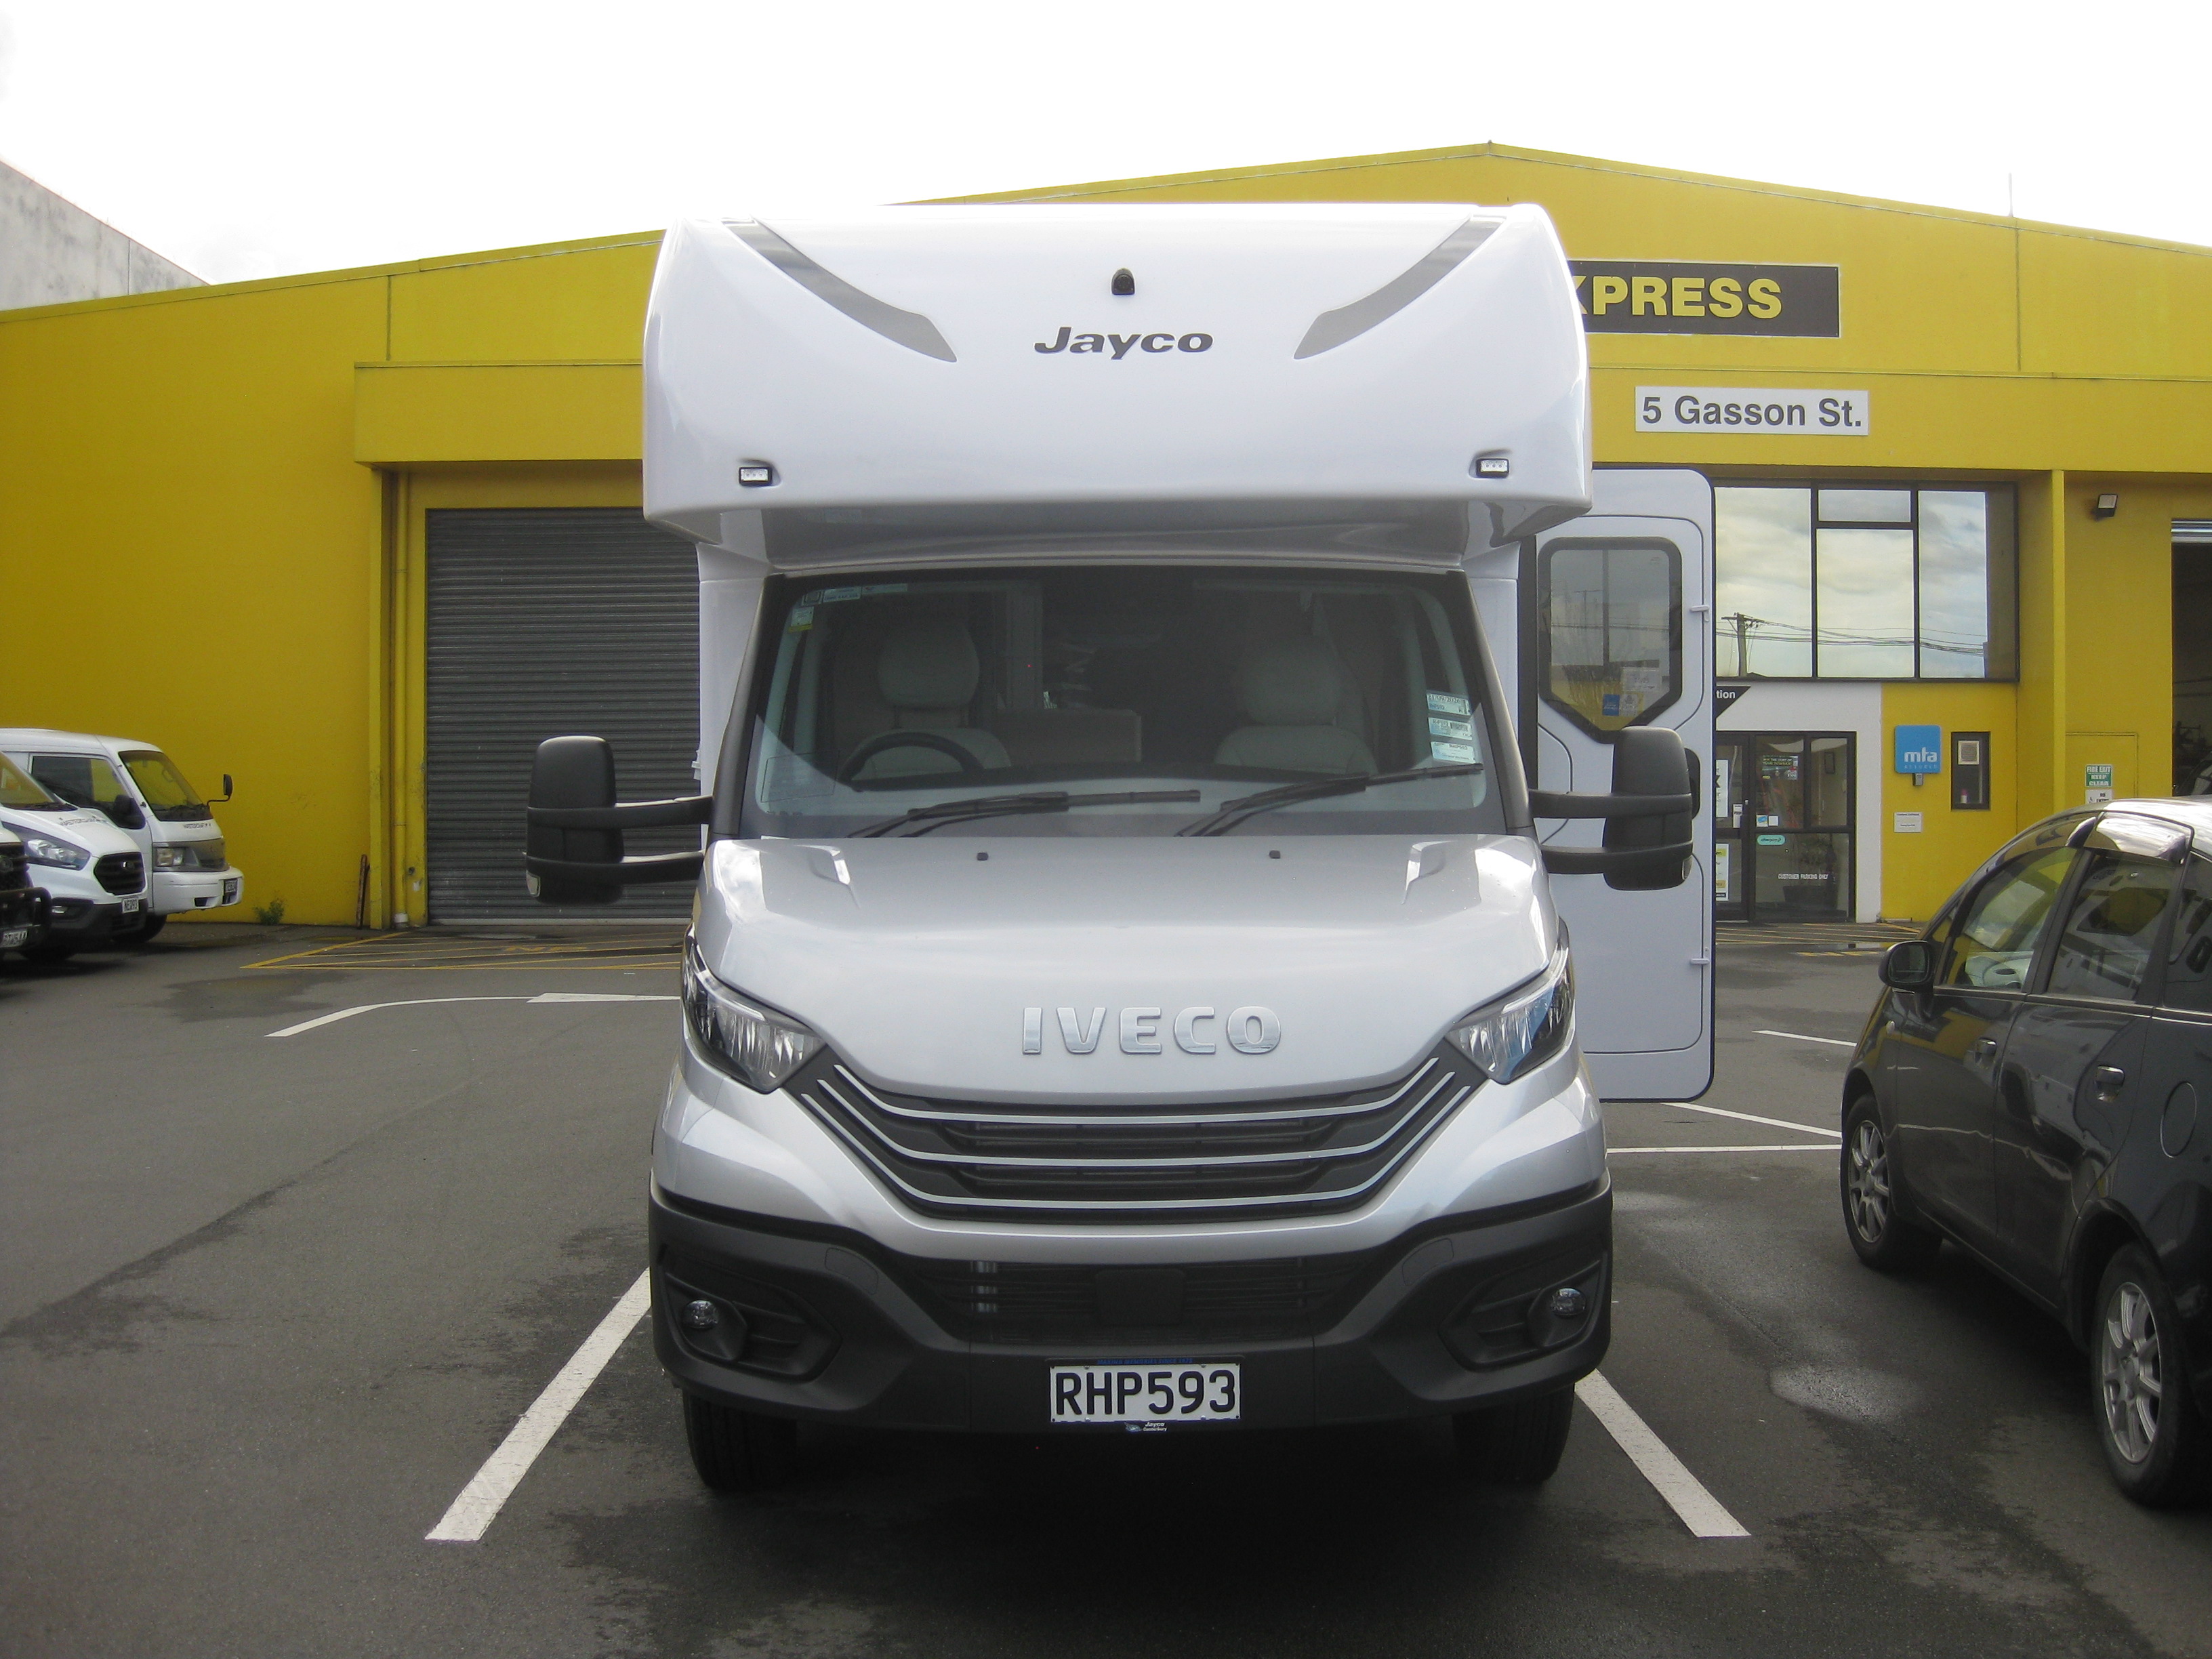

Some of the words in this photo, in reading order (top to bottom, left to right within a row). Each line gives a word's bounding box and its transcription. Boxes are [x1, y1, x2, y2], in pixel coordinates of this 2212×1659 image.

[1034, 327, 1214, 360] Jayco
[1642, 396, 1662, 424] 5
[1675, 395, 1806, 426] Gasson
[1818, 398, 1862, 427] St.
[1904, 747, 1938, 762] mta
[1022, 1006, 1282, 1054] IVECO
[1056, 1370, 1235, 1415] RHP593
